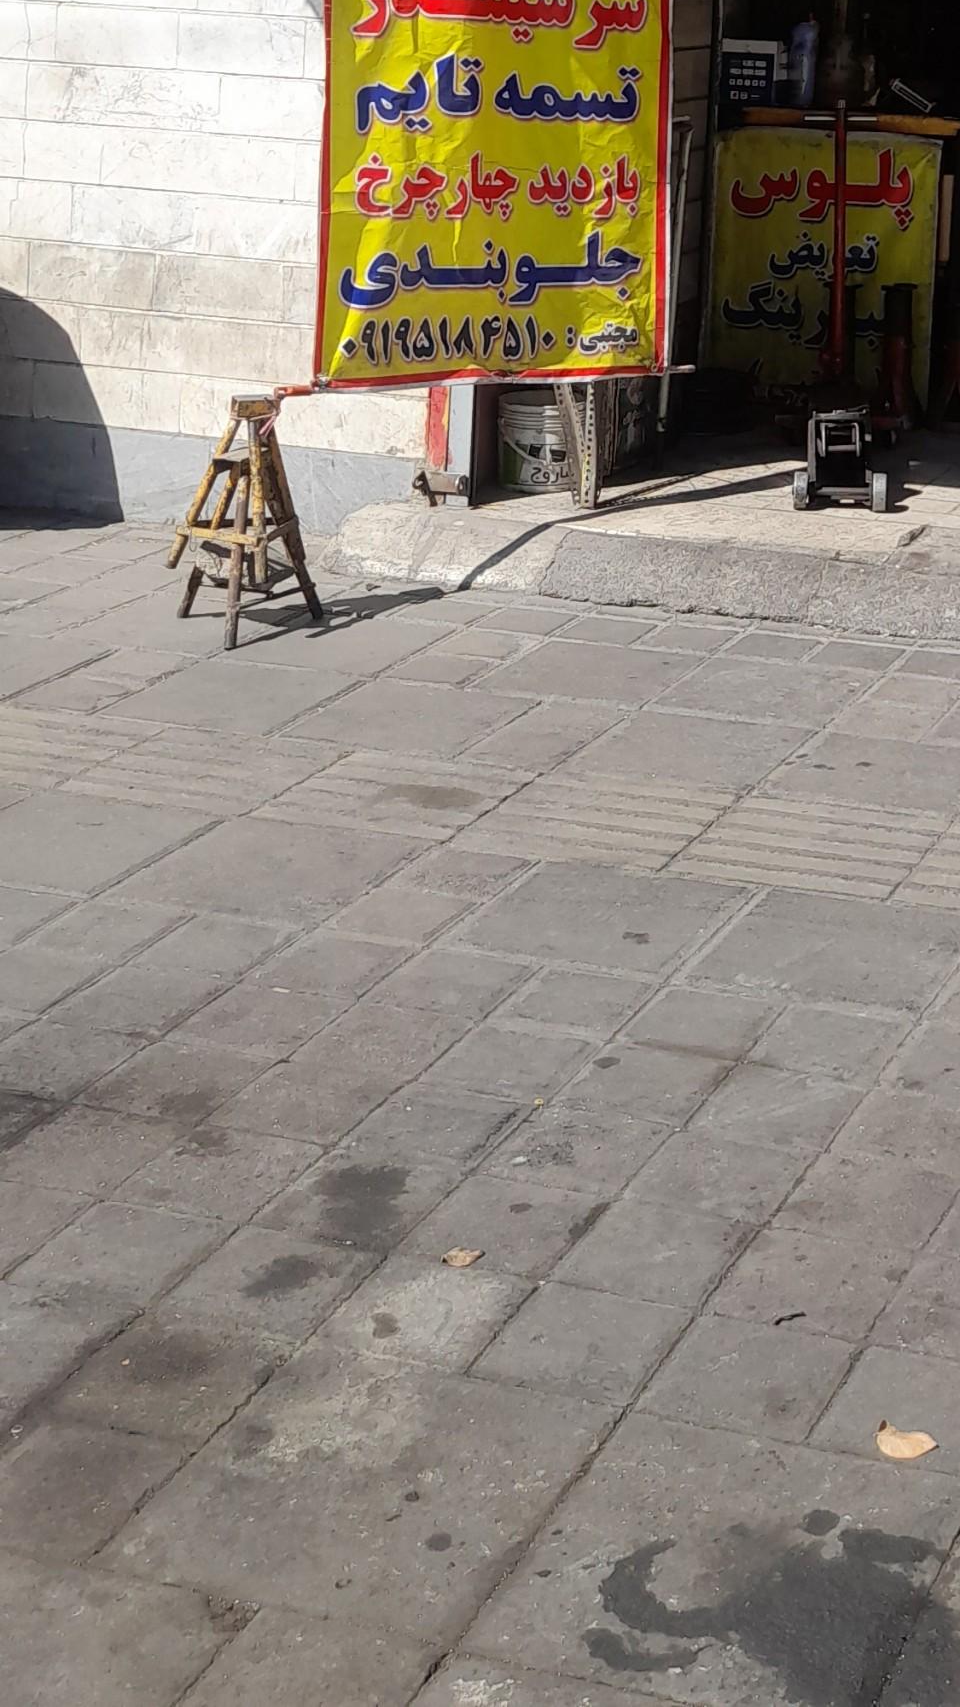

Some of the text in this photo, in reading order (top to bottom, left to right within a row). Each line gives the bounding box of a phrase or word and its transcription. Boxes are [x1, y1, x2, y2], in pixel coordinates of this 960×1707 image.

[355, 52, 641, 134] تسمه تایم
[529, 155, 640, 219] بازدید
[731, 148, 914, 230] پلوس
[339, 230, 642, 308] جلوبندی
[770, 231, 880, 282] تعیض
[340, 314, 556, 365] ۰۹۱۹۵۱۸۴۵۱۰
